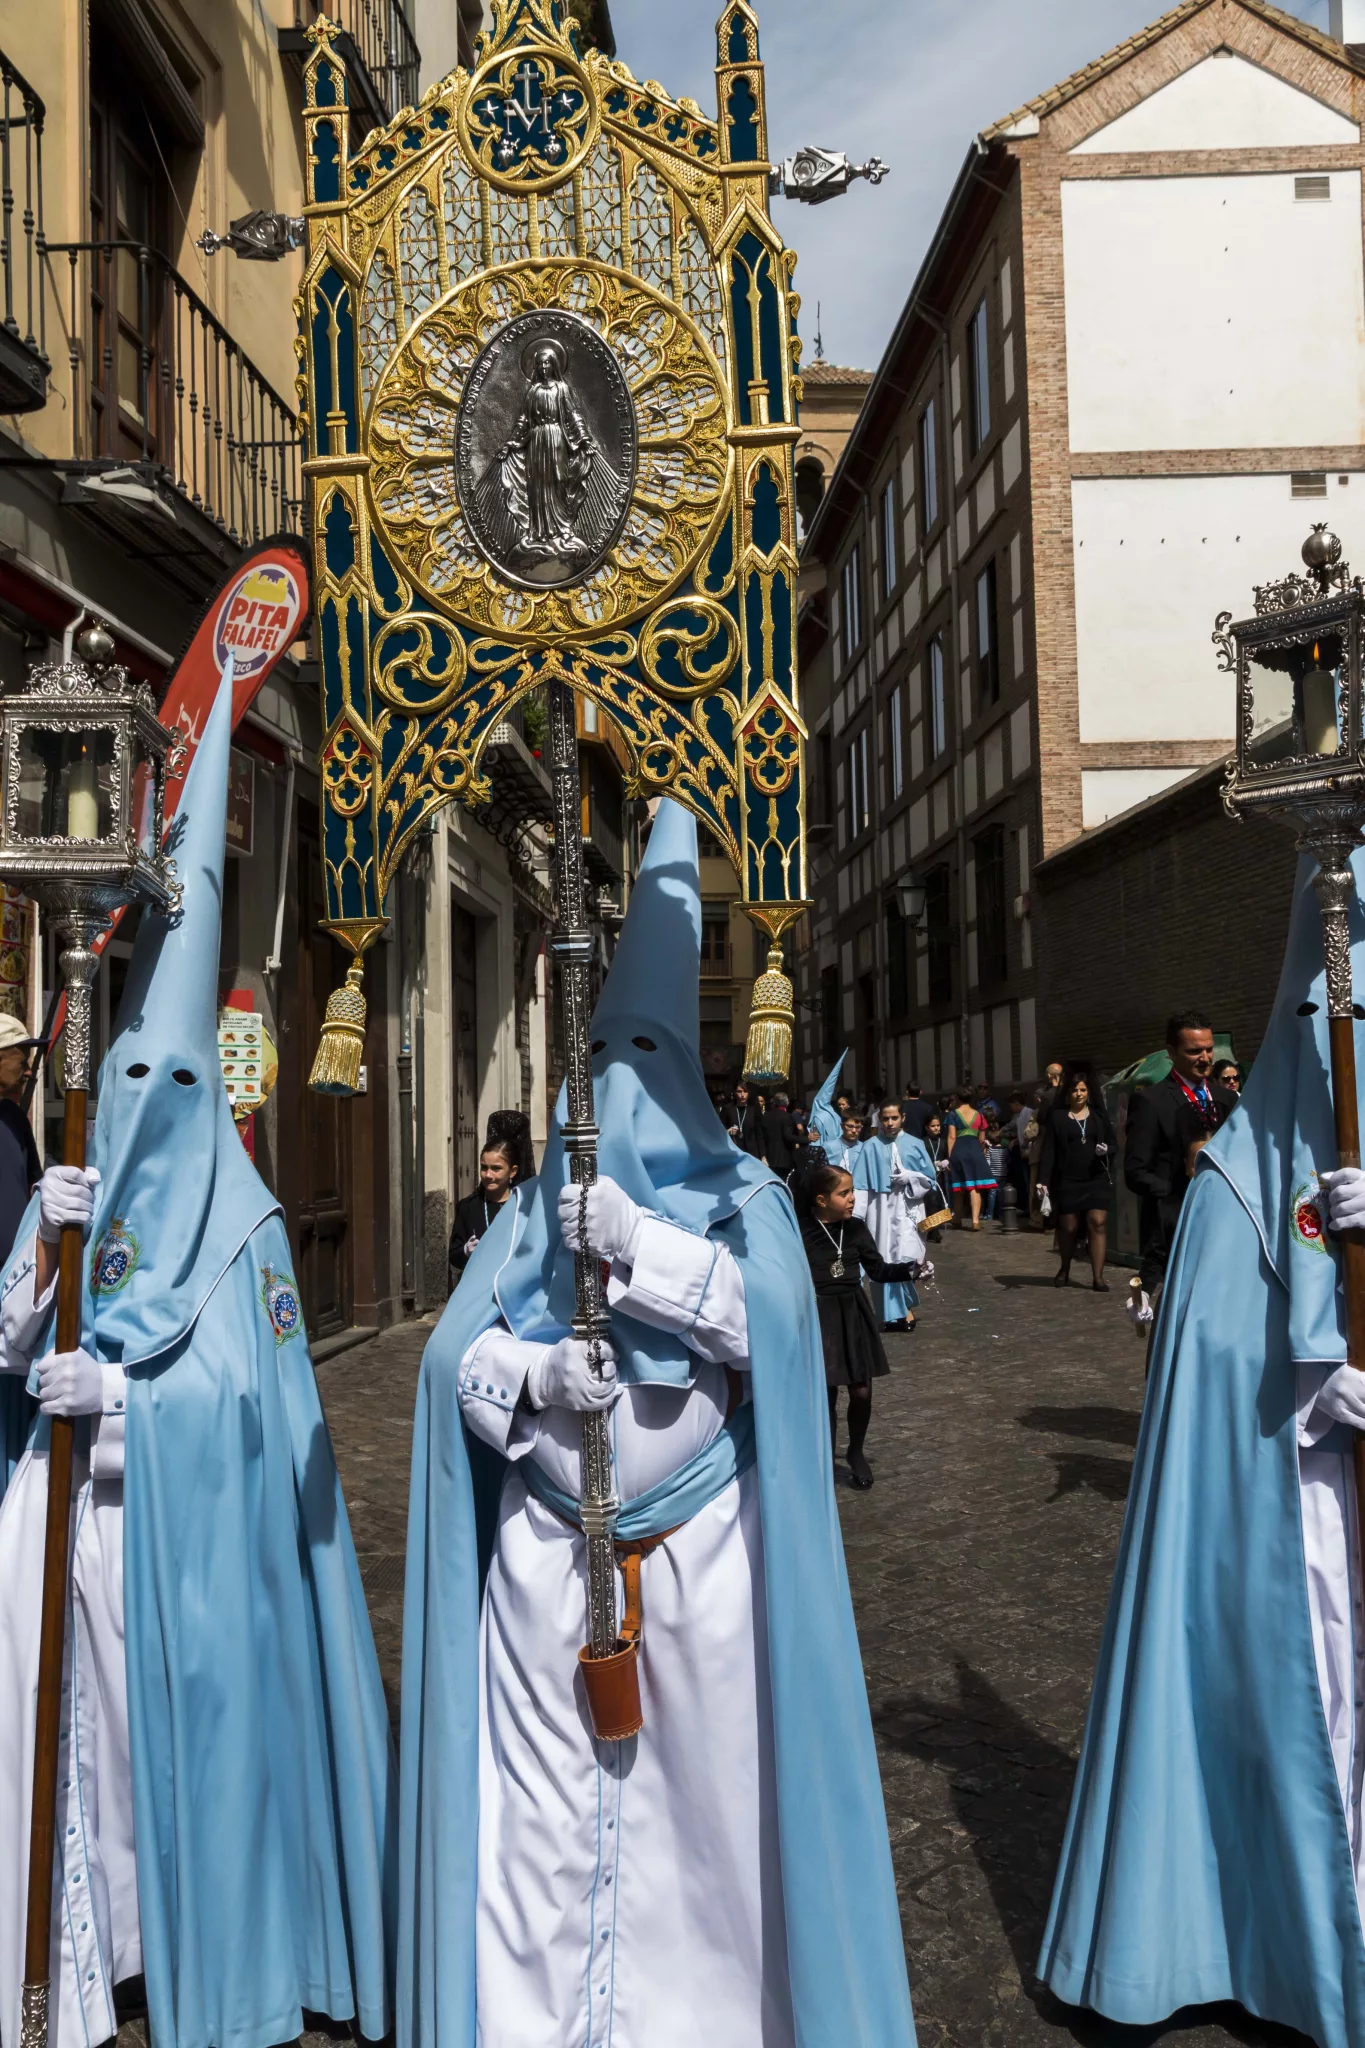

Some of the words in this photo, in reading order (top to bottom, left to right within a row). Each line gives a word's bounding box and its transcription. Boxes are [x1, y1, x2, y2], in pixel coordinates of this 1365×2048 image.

[500, 316, 542, 344] ROGAD
[574, 322, 622, 389] NOSOTROS
[465, 346, 501, 414] CONCEBIDA
[459, 419, 472, 471] PECADO
[228, 597, 290, 630] PITA
[219, 623, 280, 651] FALAFEL
